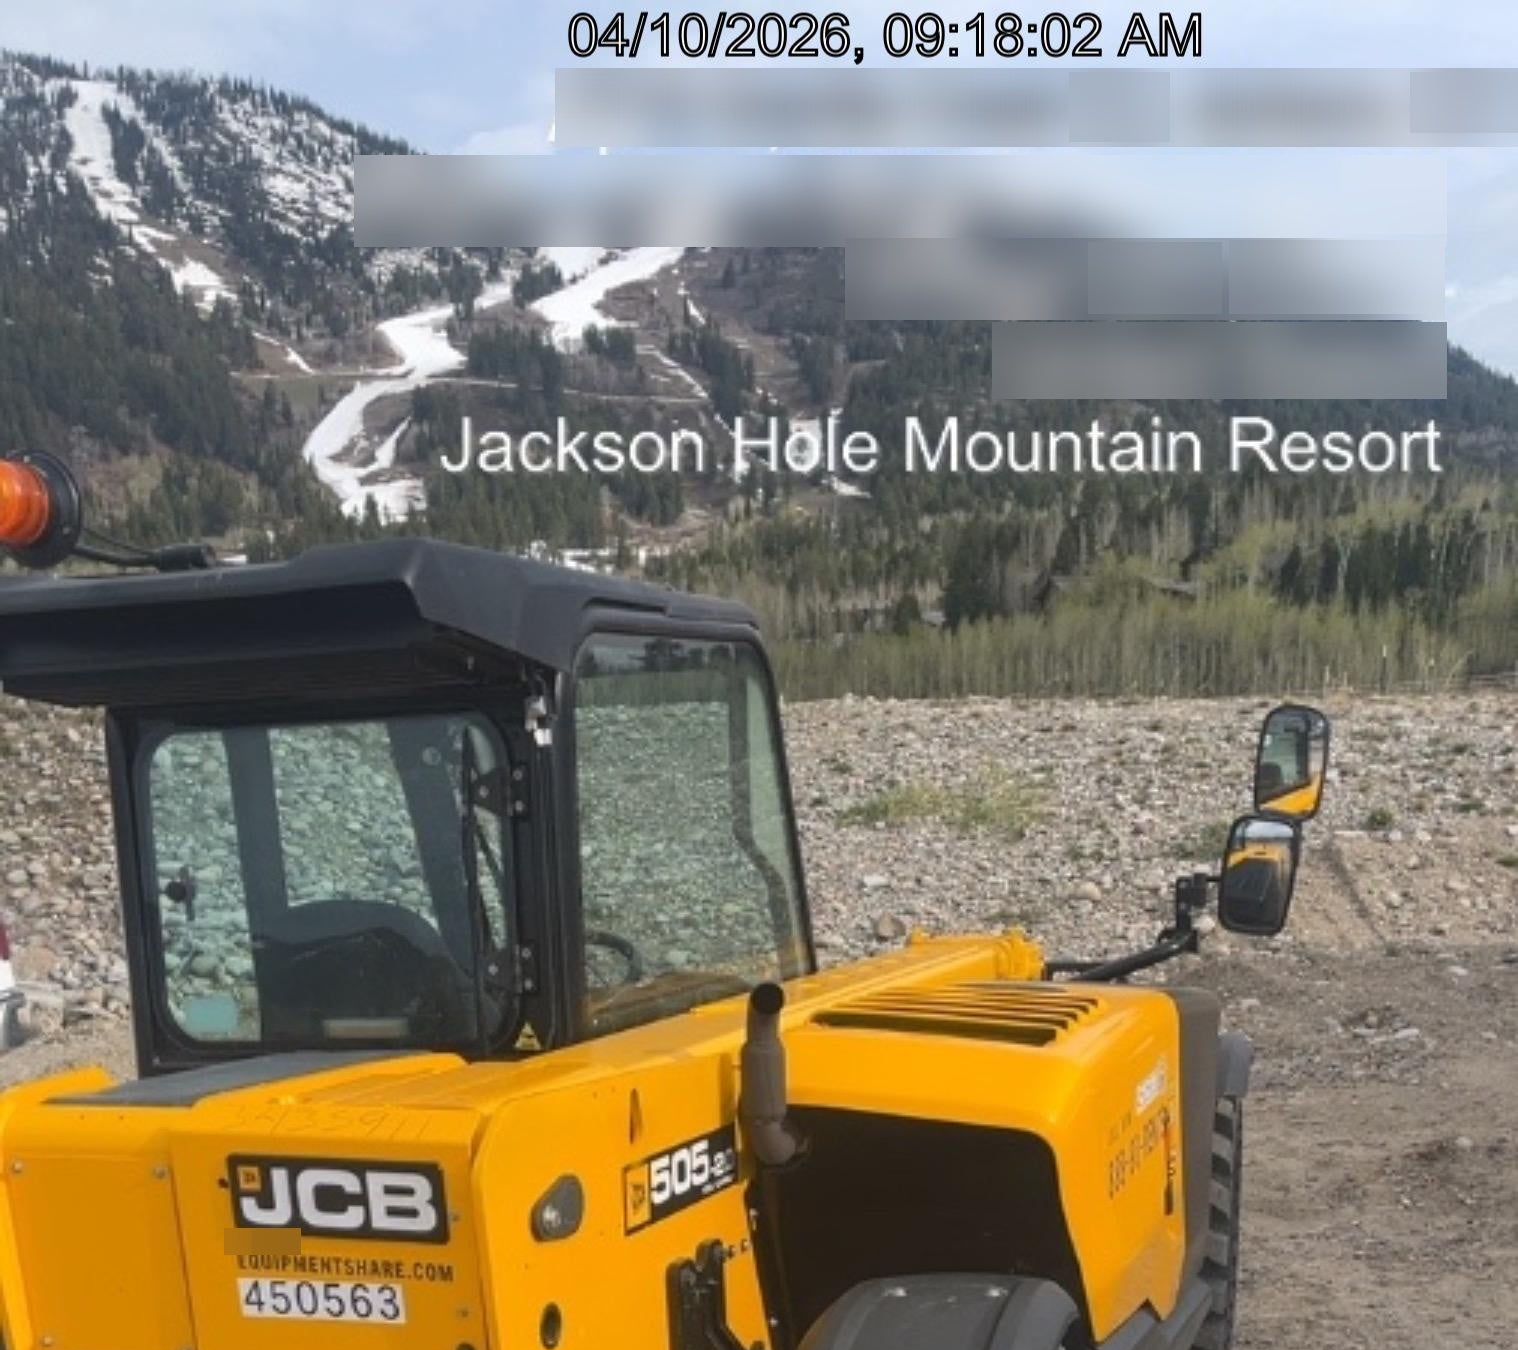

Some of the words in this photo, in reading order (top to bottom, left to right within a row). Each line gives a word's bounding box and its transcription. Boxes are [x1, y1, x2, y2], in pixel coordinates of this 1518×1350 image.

[239, 1167, 438, 1231] JCB
[238, 1255, 453, 1281] EQUIPMENTSHARE.COM
[244, 1281, 401, 1320] 450563
